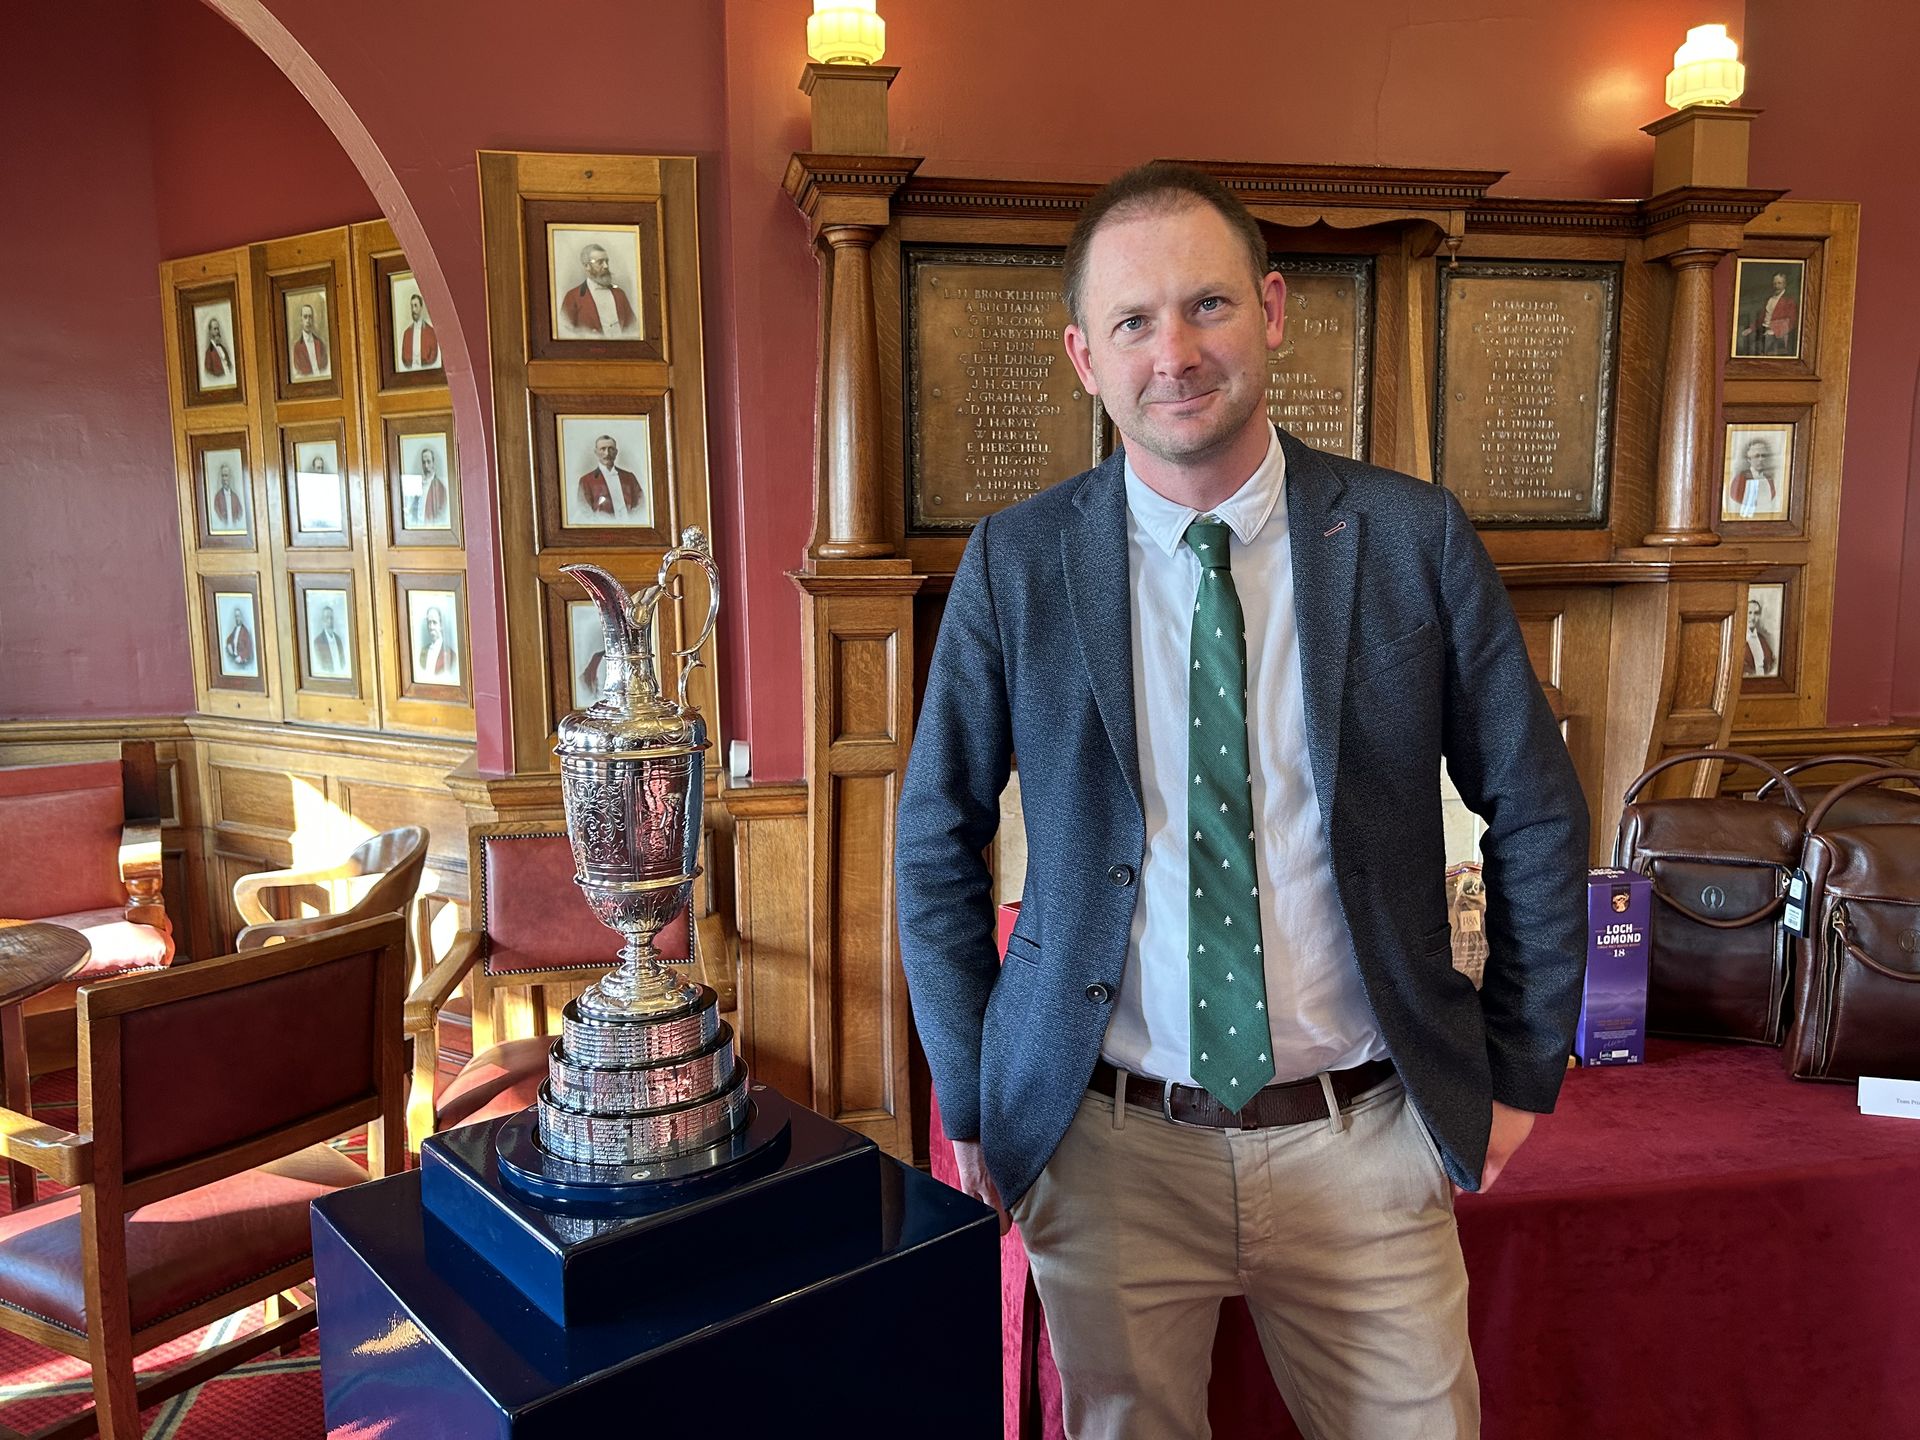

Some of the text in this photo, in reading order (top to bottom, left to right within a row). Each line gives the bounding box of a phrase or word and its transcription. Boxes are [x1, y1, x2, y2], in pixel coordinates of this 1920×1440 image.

[974, 289, 1063, 301] BROCKLEHURS
[980, 303, 1050, 313] BUCHANAN
[1010, 316, 1045, 326] COOK
[982, 328, 1060, 339] DARBYSHIRE
[1006, 342, 1035, 352] DUN
[1005, 354, 1056, 365] DUNLOP
[983, 367, 1049, 377] FITZHUGH
[1001, 380, 1043, 390] GETTY
[979, 392, 1032, 403] GRAHAM
[1002, 405, 1060, 416] GRAYSON
[989, 418, 1038, 428] HARVEY
[992, 430, 1040, 440] HARVEY
[980, 443, 1052, 453] HERSCHELL
[994, 455, 1048, 466] HIGGINS
[988, 481, 1041, 490] HUGHES
[1606, 923, 1633, 935] LOCH
[1597, 933, 1641, 945] LOMOND
[1613, 949, 1625, 957] 18
